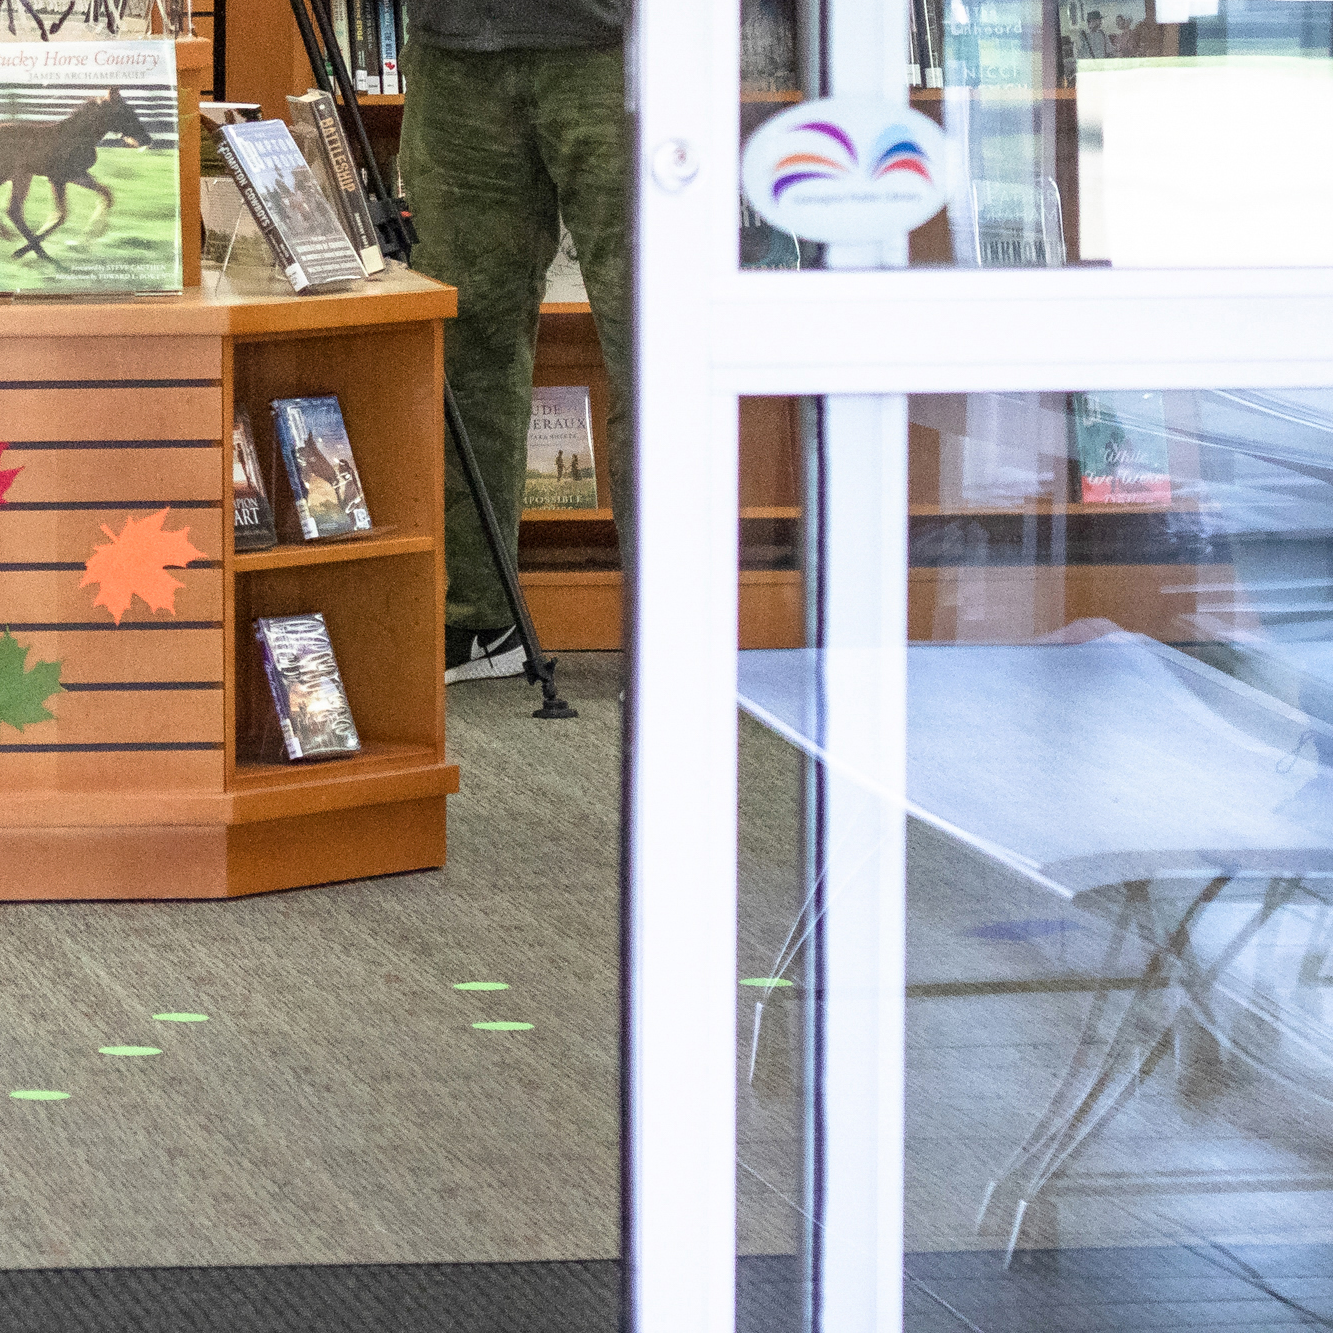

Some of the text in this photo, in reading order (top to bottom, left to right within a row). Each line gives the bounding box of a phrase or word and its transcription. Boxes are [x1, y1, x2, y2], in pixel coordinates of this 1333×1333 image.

[29, 71, 61, 82] JAMES
[44, 50, 89, 67] Horse
[94, 50, 161, 71] Country
[320, 116, 356, 192] BATTLESHIP
[222, 146, 271, 228] COMPTON COWBOYS
